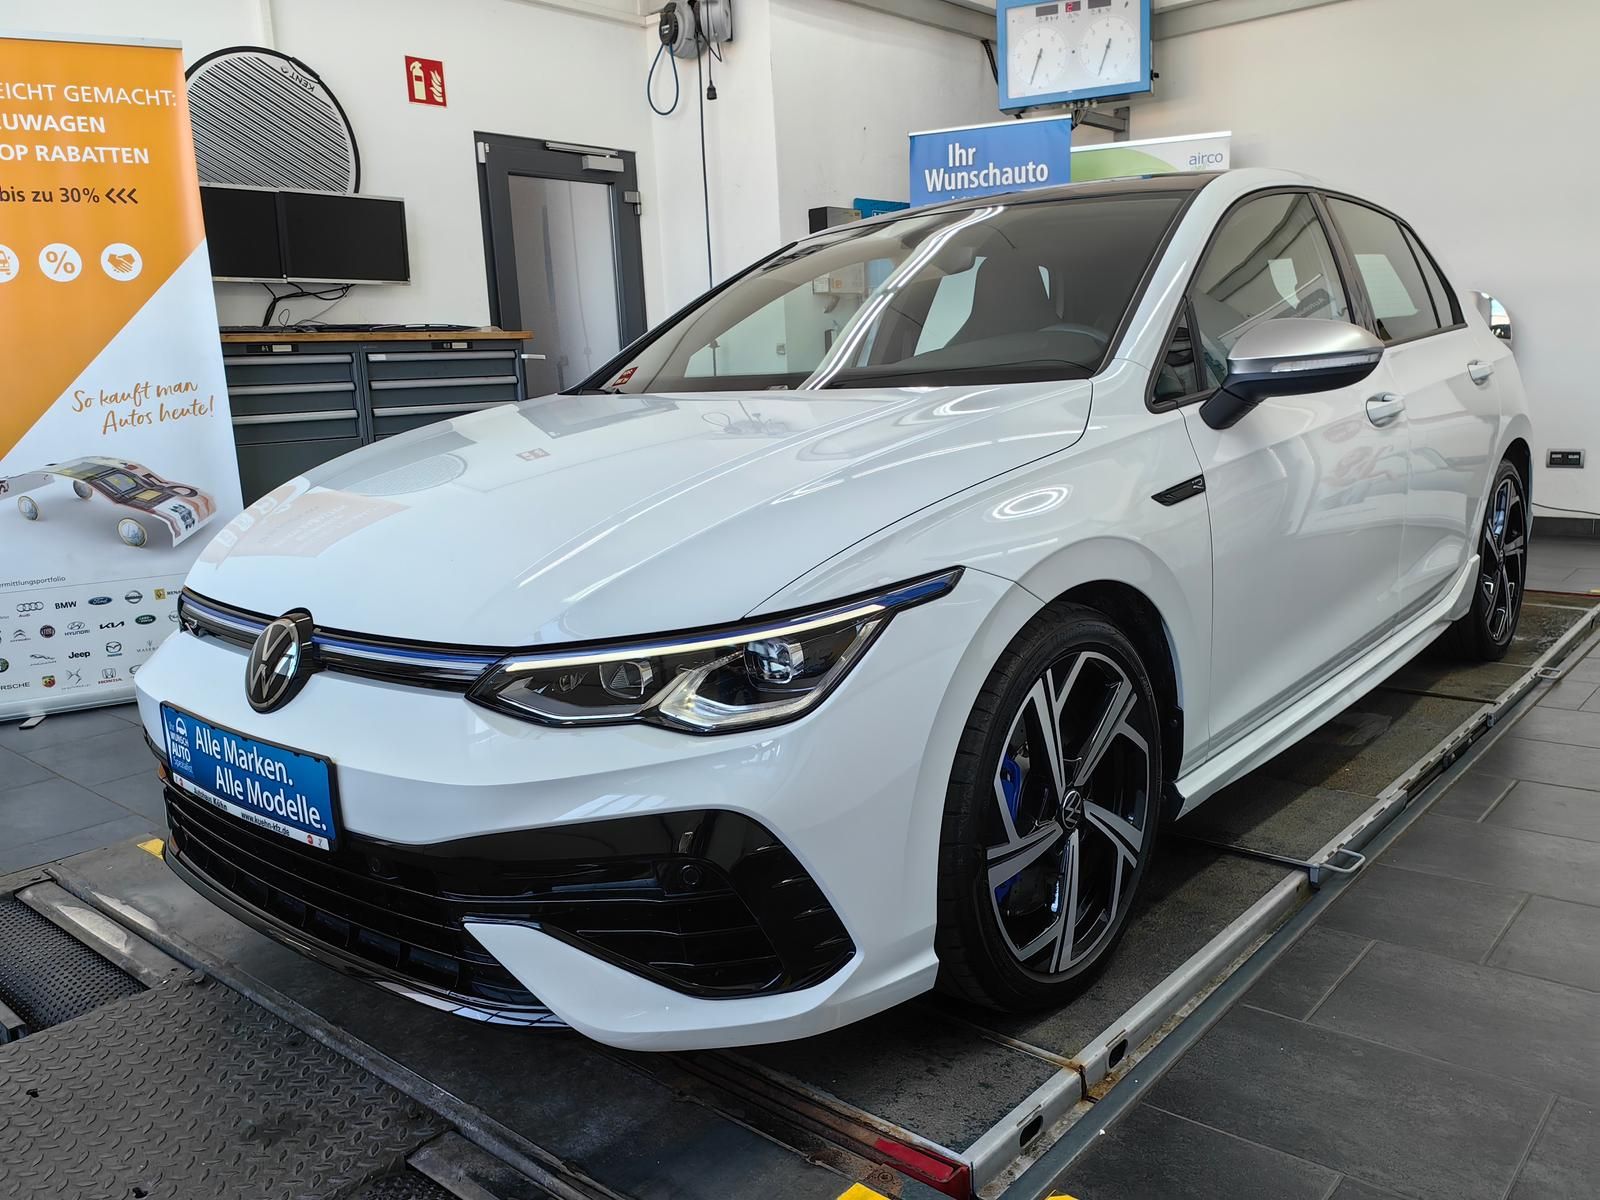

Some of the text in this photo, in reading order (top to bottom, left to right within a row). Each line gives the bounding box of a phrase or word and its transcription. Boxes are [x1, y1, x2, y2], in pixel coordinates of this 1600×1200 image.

[290, 72, 315, 92] KENT
[64, 86, 176, 106] GEMACHT:
[0, 113, 106, 133] UWAGEN
[36, 145, 150, 164] RABATTEN
[948, 143, 976, 168] Ihr
[1189, 152, 1224, 166] airco
[924, 161, 1048, 192] Wunschauto
[0, 186, 100, 204] bis zu 30%
[72, 381, 198, 412] So kauft man
[102, 395, 214, 434] Autos heute!
[0, 576, 66, 588] rmittlungsportfolio
[54, 601, 77, 610] BMW
[172, 741, 190, 762] AUTO
[195, 726, 294, 786] Alle Marken.
[216, 766, 327, 831] Alle Modelle.
[240, 812, 290, 836] www.kuehn-kfz.de
